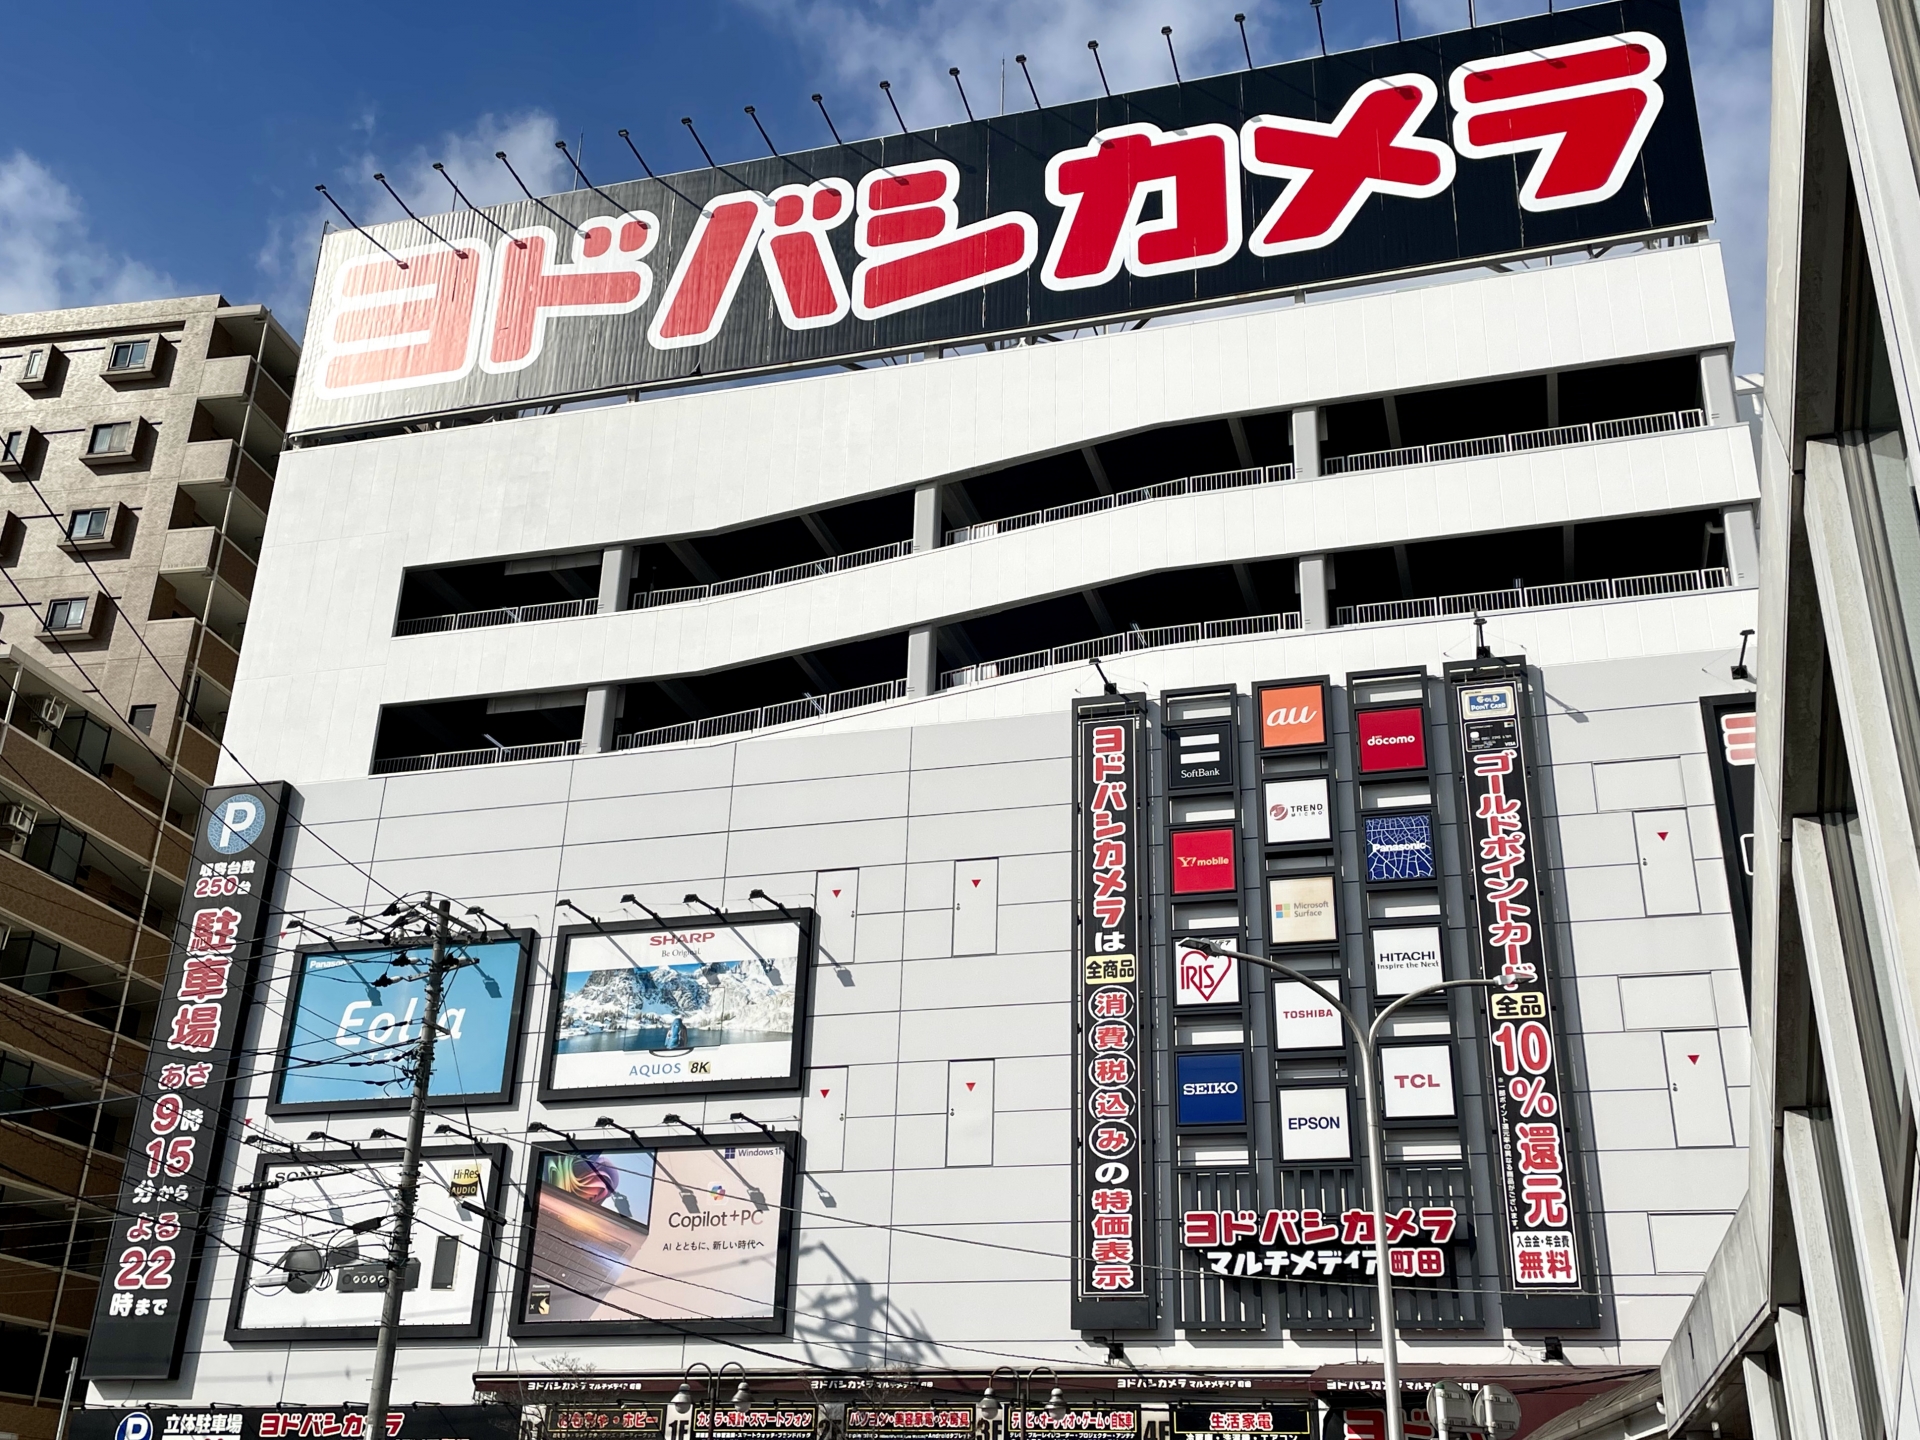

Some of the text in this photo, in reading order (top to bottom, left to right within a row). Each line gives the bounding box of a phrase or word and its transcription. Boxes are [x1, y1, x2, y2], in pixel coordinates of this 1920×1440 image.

[316, 29, 1667, 400] ヨドバシカメラ
[1266, 705, 1318, 727] au
[1367, 735, 1416, 746] docomo
[1181, 767, 1221, 779] SoftBank
[1290, 803, 1323, 813] TREND
[219, 801, 257, 848] P
[1091, 725, 1127, 952] ヨドバシカメラは
[1372, 841, 1427, 853] Panasonic
[1473, 750, 1538, 990] ゴールドポイントカード
[194, 875, 252, 898] 250台
[1293, 900, 1329, 910] Microsoft
[1294, 908, 1323, 918] Surface
[649, 931, 716, 946] SHARP
[661, 950, 671, 958] Be
[1379, 950, 1436, 962] HITACHI
[1086, 959, 1135, 980] 全商品
[1377, 961, 1405, 970] Inspire
[1420, 960, 1439, 968] Next
[167, 906, 242, 1053] 駐車場
[1180, 965, 1214, 990] IRIS
[1283, 1008, 1333, 1019] TOSHIBA
[1495, 995, 1542, 1017] 全品
[335, 997, 466, 1046] Eola
[158, 1062, 213, 1090] あさ
[629, 1061, 710, 1078] AQUOS 8K
[1183, 1081, 1238, 1096] SEIKO
[1394, 1074, 1440, 1088] TCL
[151, 1093, 204, 1136] 9時
[1288, 1116, 1340, 1130] EPSON
[1089, 988, 1134, 1291] 消費税込みの特価表示
[146, 1136, 196, 1178] 15
[738, 1148, 775, 1157] Windows
[275, 1170, 325, 1183] SONY
[453, 1168, 480, 1180] Hi-Res
[132, 1179, 189, 1203] 分から
[451, 1184, 477, 1195] AUDIO
[126, 1212, 181, 1242] よる
[1184, 1207, 1457, 1247] ヨドバシカメラ
[662, 1243, 672, 1251] AI
[1516, 1234, 1570, 1248] 入会金・年会費
[114, 1245, 176, 1290] 22
[1207, 1247, 1445, 1277] マルチメディア 町田
[1518, 1250, 1572, 1279] 無料
[109, 1291, 168, 1317] 時まで
[1117, 1379, 1187, 1389] ヨドバシカメラ
[163, 1413, 243, 1434] 立体駐車場
[259, 1412, 405, 1437] ヨドバシカラ
[1209, 1412, 1273, 1432] 生活家電
